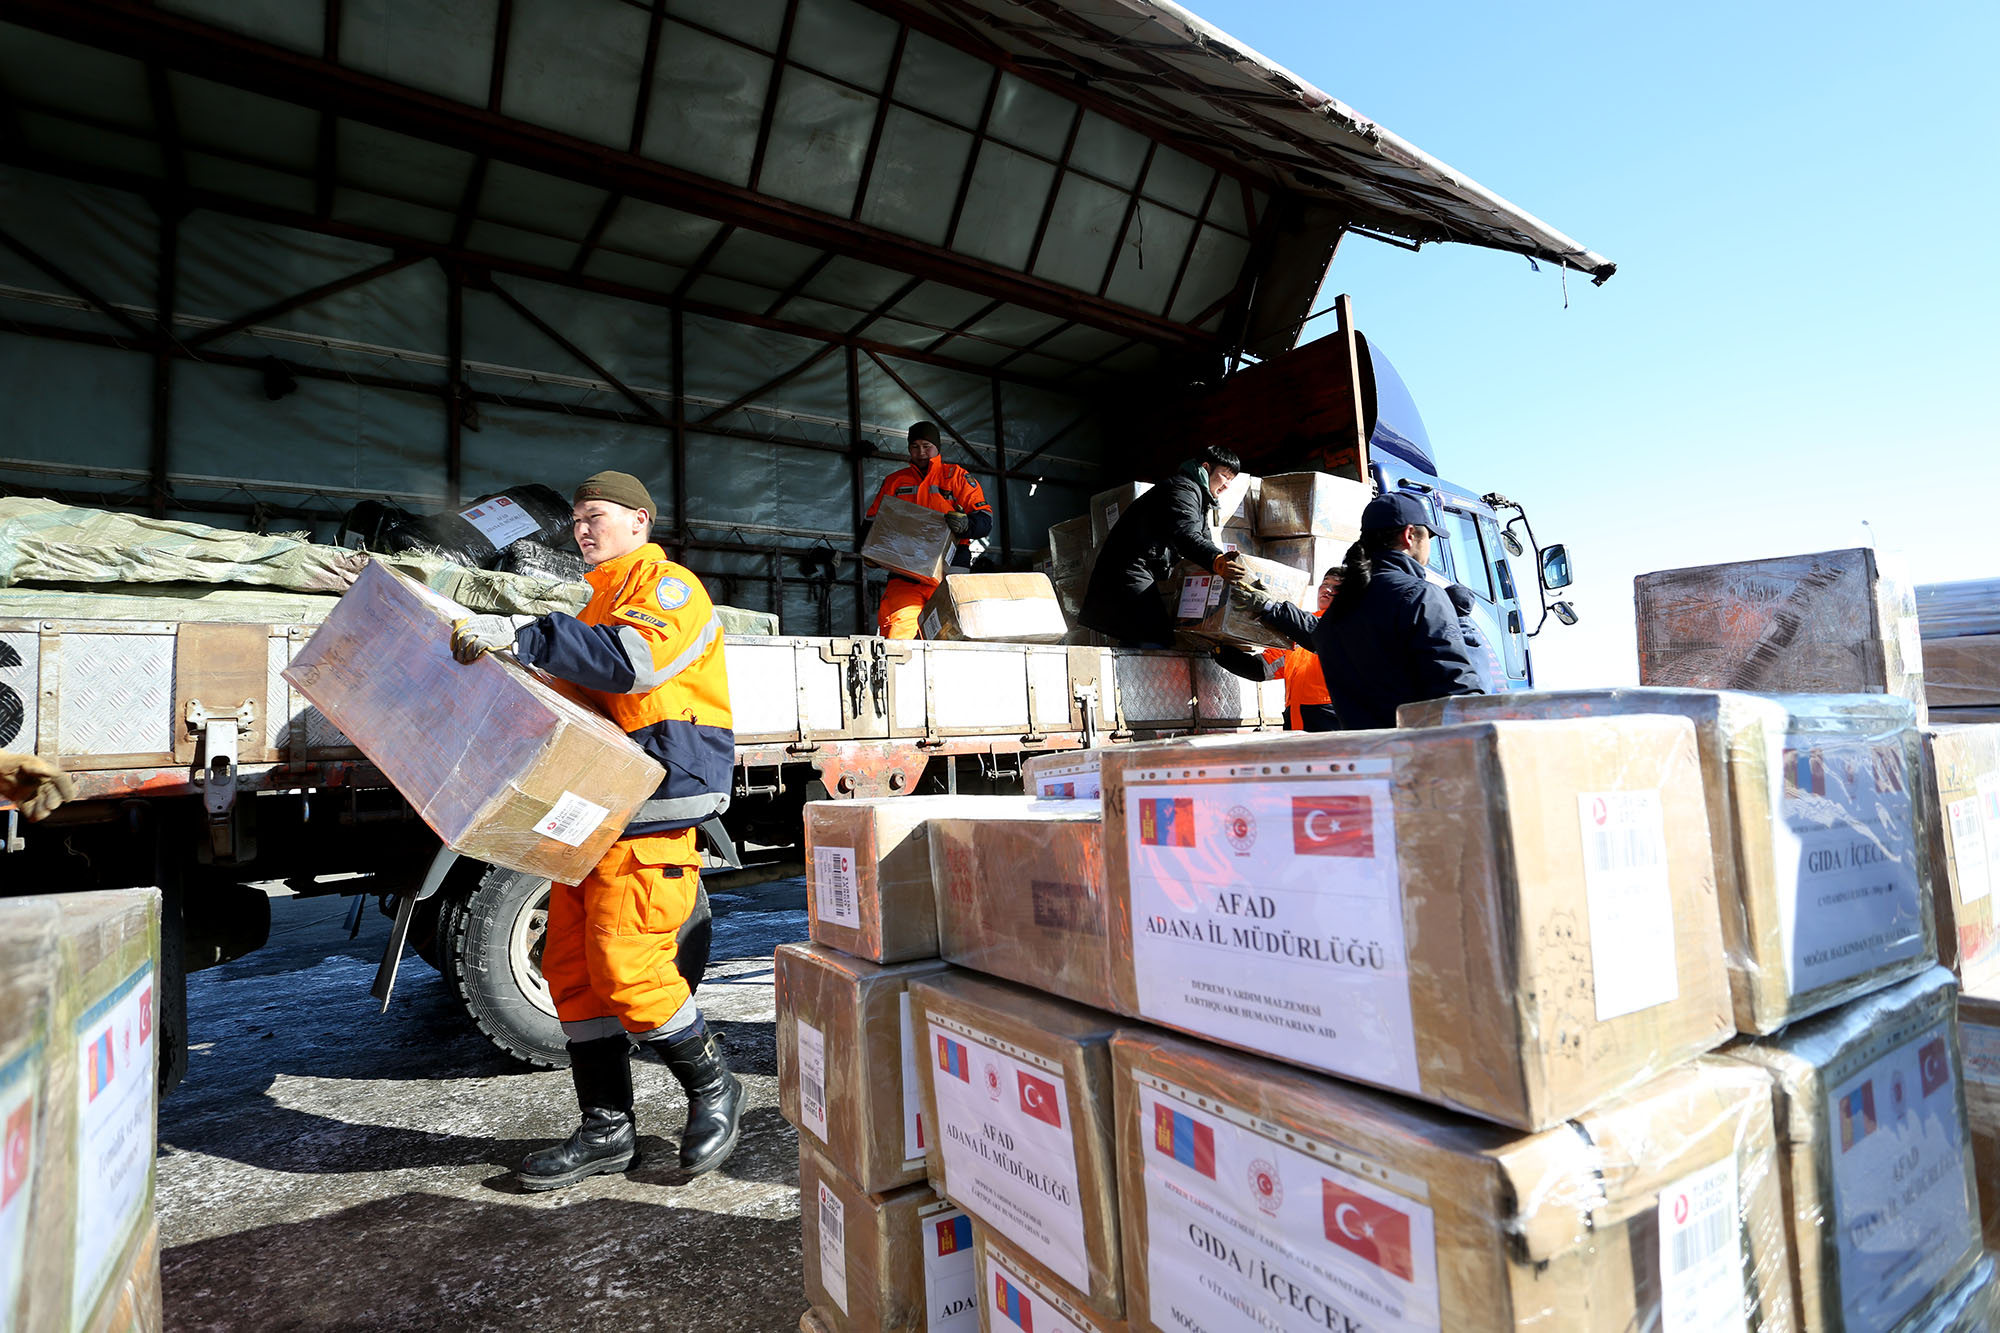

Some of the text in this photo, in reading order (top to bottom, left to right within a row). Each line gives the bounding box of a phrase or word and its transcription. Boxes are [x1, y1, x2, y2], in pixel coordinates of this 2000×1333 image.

[1808, 850, 1842, 873] GIDA
[1215, 892, 1276, 920] AFAD
[1144, 916, 1385, 970] ADANA İL MÜDÜRLÜĞÜ
[1192, 980, 1322, 1017] DEPREM YARDIM MALZEMESİ
[1184, 994, 1337, 1039] EARTHQUAKE HUMANITARIAN AID
[982, 1122, 1016, 1152] AFAD
[946, 1122, 1072, 1207] ADANA İL MÜDÜRLÜĞÜ
[1189, 1223, 1243, 1274] GIDA
[1248, 1258, 1254, 1279] /
[942, 1294, 978, 1318] ADA
[1171, 1306, 1206, 1333] MOĞO
